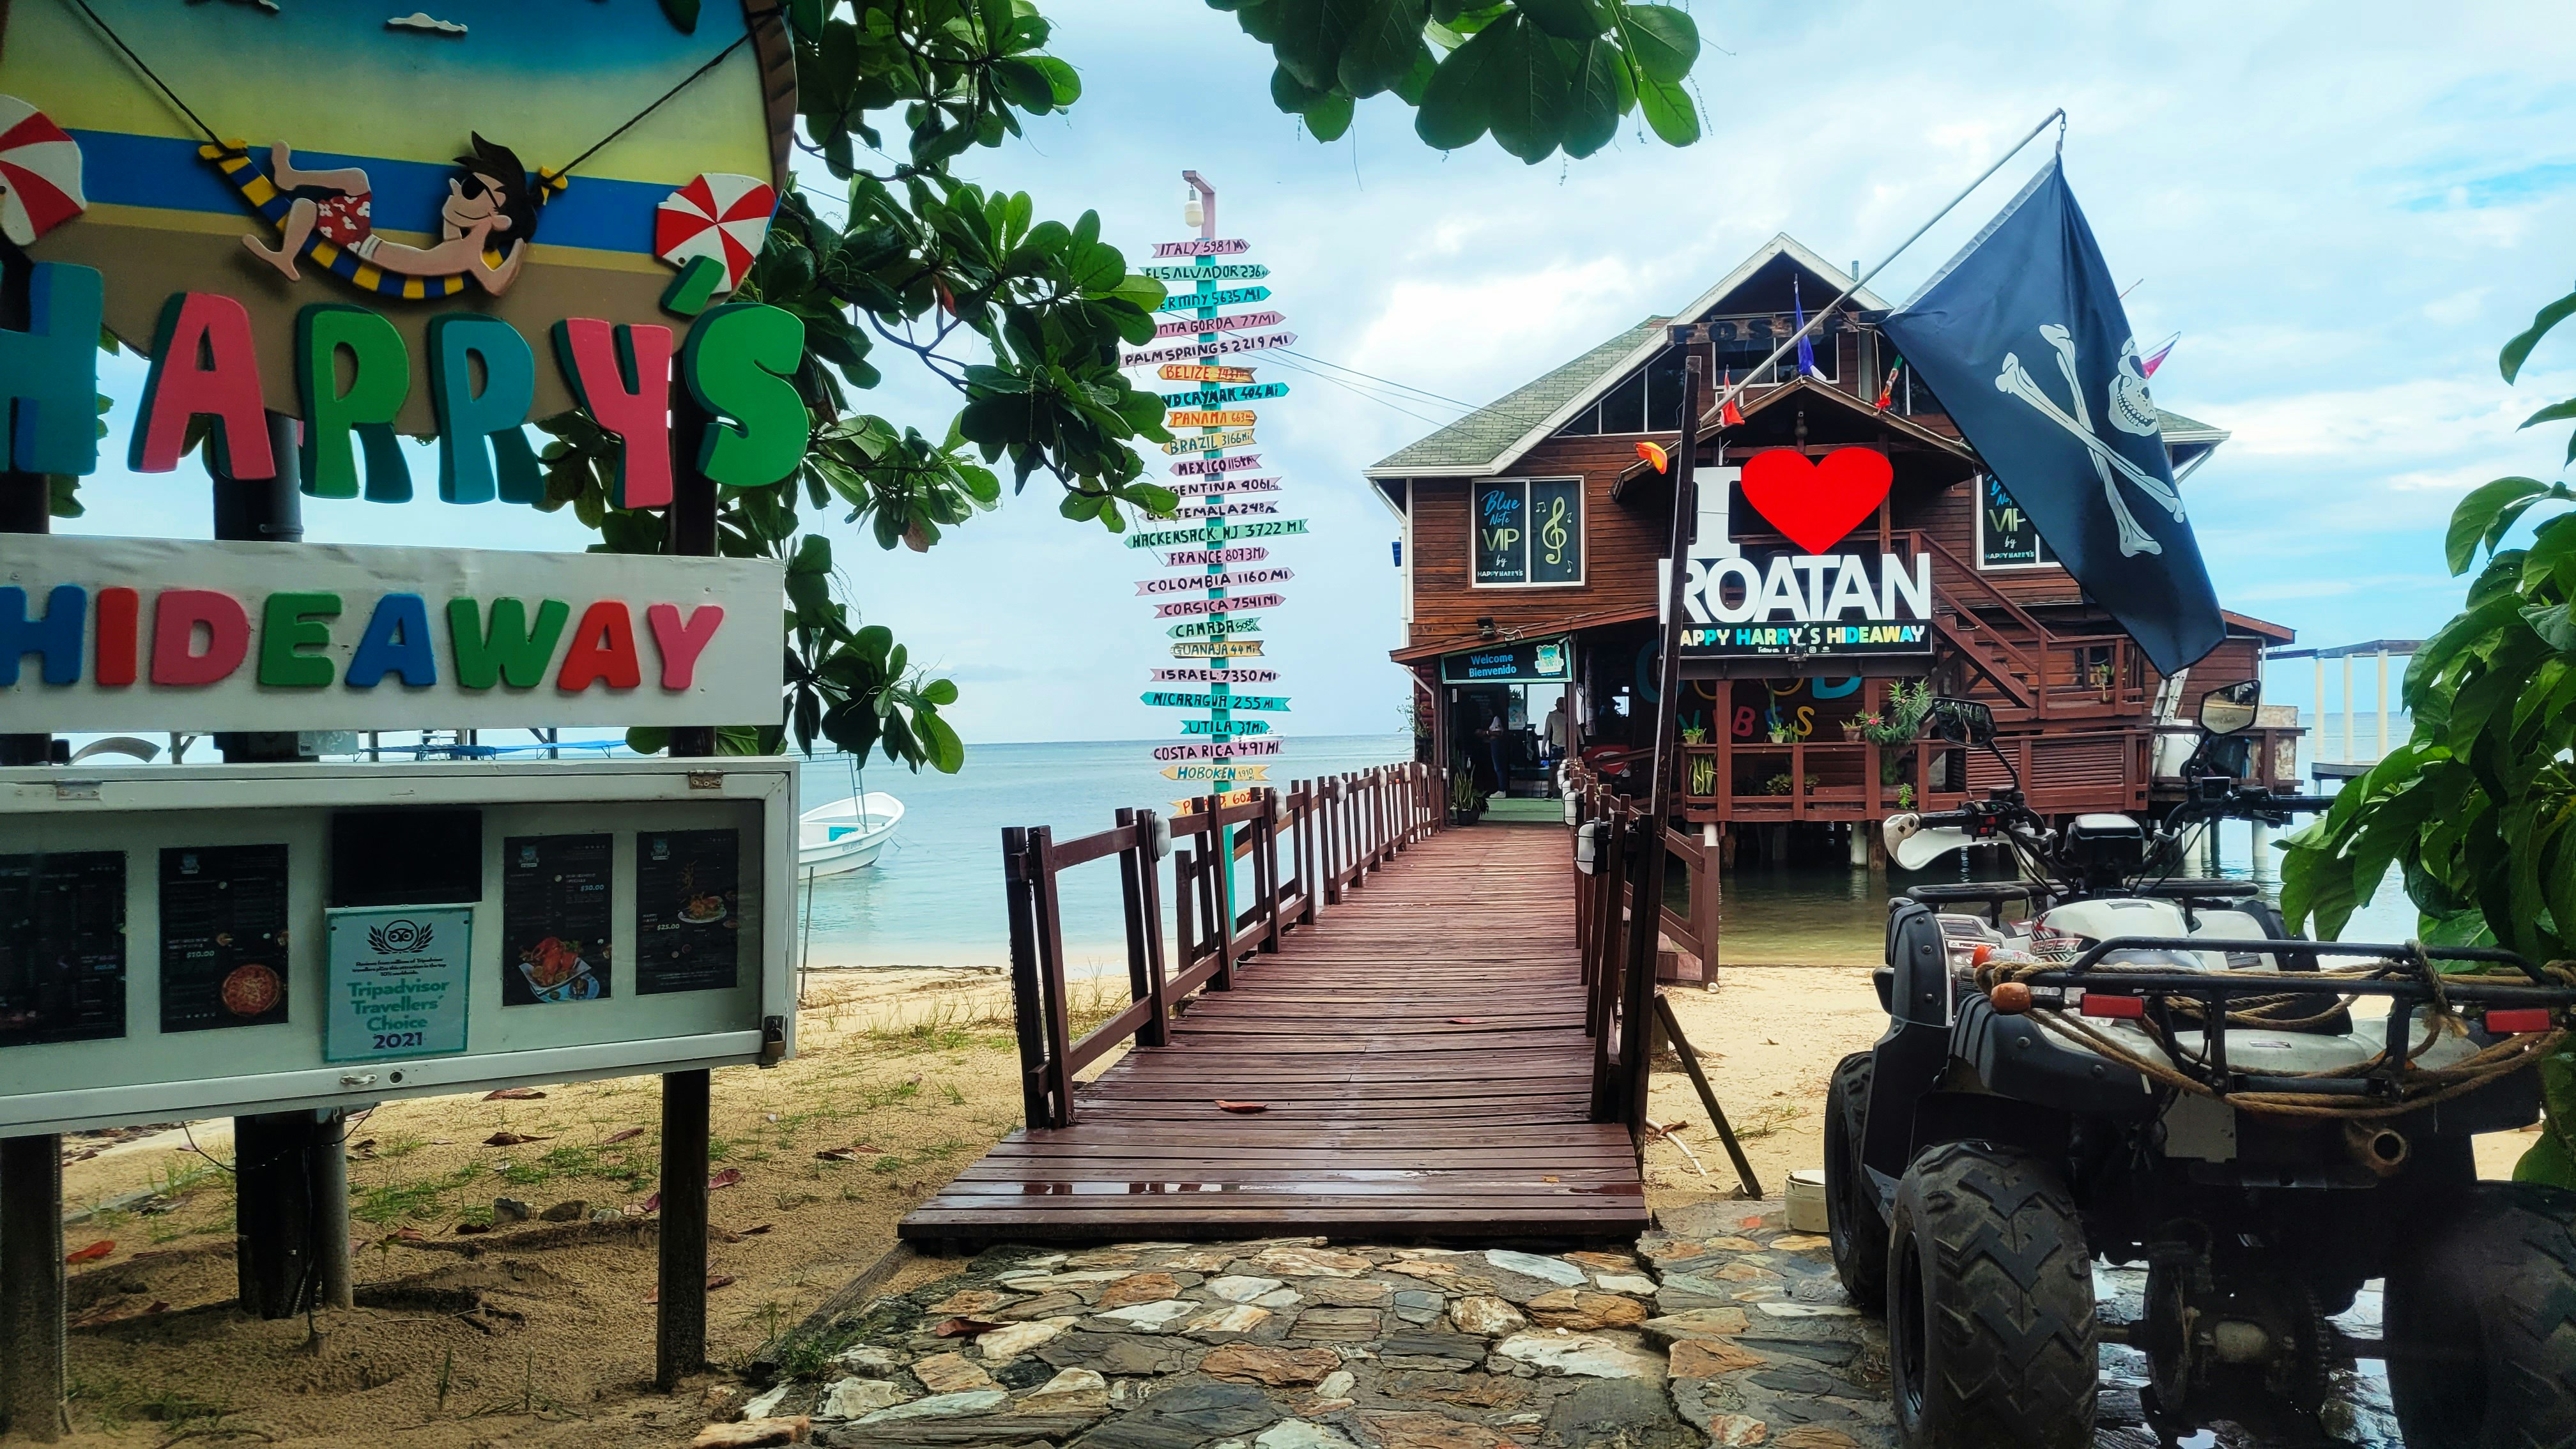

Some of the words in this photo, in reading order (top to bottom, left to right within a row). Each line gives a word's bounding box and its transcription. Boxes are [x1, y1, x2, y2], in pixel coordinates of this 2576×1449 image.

[1160, 241, 1200, 256] ITALY
[1211, 290, 1241, 305] 5635
[1190, 317, 1235, 333] GORDA
[1124, 352, 1163, 365] PALM
[1165, 342, 1229, 362] SPRINGS
[1232, 336, 1265, 353] 2219
[1269, 335, 1289, 348] MI
[1165, 365, 1211, 380] BELIZE
[1240, 387, 1263, 401] 404
[1173, 411, 1227, 426] PANAMA
[1170, 434, 1218, 455] BRAZIL
[1221, 433, 1242, 446] 3166
[1177, 459, 1227, 475] MEXICO
[1163, 481, 1237, 496] GENTINA
[1480, 489, 1521, 516] Blue
[1146, 503, 1239, 521] GUTEMALA
[1489, 510, 1512, 526] Note
[1687, 466, 1742, 558] I
[1132, 527, 1217, 548] HACKENSACK
[1245, 522, 1282, 537] 3722
[1482, 528, 1521, 551] VIP
[2004, 535, 2018, 549] by
[1170, 549, 1222, 566] FRANCE
[1225, 548, 1252, 562] 8073
[1496, 554, 1508, 568] by
[1147, 574, 1231, 593] COLOMBIA
[1238, 571, 1268, 584] 1160
[1270, 569, 1288, 581] MI
[1658, 553, 1932, 624] ROATAN
[1163, 599, 1229, 616] CORSICA
[1231, 597, 1262, 609] 7541
[0, 583, 724, 692] HIDEAWAY
[1175, 620, 1235, 638] CANADA
[1680, 628, 1730, 647] APPY
[1827, 625, 1925, 645] HIDEAWAY
[1173, 643, 1229, 656] GUANAJA
[1471, 653, 1514, 665] Welcome
[1161, 670, 1217, 681] ISRAEL
[1221, 670, 1257, 682] 7350
[1469, 664, 1517, 678] Bienvenido
[1153, 692, 1228, 708] NICARAGUA
[1232, 696, 1261, 710] 255
[1188, 721, 1232, 734] UTILA
[1153, 746, 1198, 761] COSTA
[1201, 744, 1235, 758] RICA
[1238, 742, 1263, 753] 491
[1177, 766, 1236, 781] HOBOKEN
[1238, 767, 1254, 778] 1910
[657, 923, 680, 931] $25.00
[346, 978, 450, 1000] Tripadvisor
[366, 1015, 429, 1032] Choice
[372, 1032, 423, 1049] 2021
